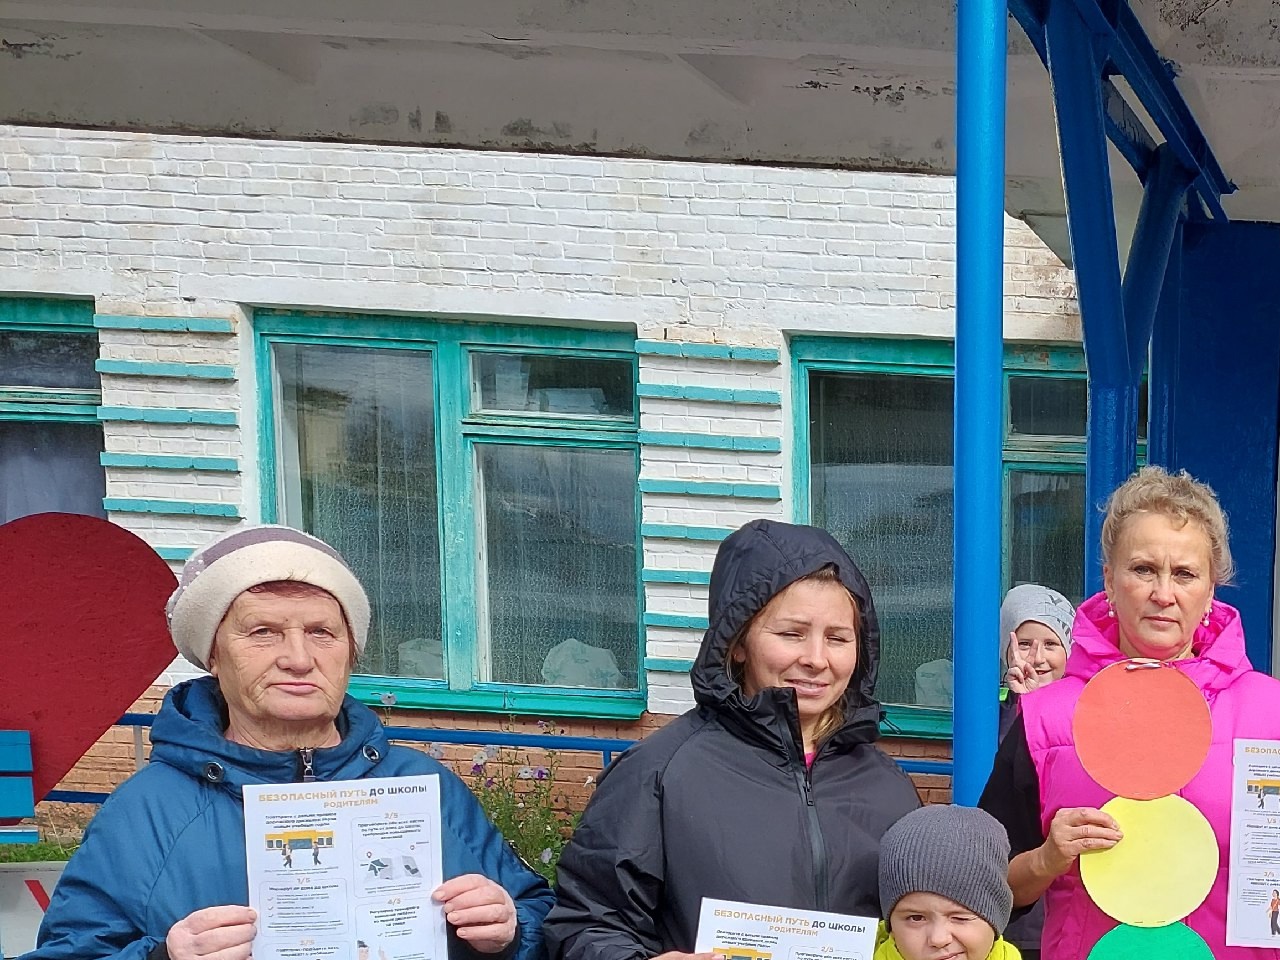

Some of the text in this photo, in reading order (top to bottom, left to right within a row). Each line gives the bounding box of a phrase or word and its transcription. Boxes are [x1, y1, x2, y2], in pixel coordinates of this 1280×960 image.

[258, 785, 426, 803] БЕЗОПАСНЫЙ ПУТЬ ДО ШКОЛЫ
[323, 797, 378, 808] РОДИТЕЛЯМ
[713, 908, 865, 933] БЕЗОПАСНЫЙ ПУТЬ ДО ШКОЛЫ
[768, 924, 818, 936] РОДИТЕЛЯМ
